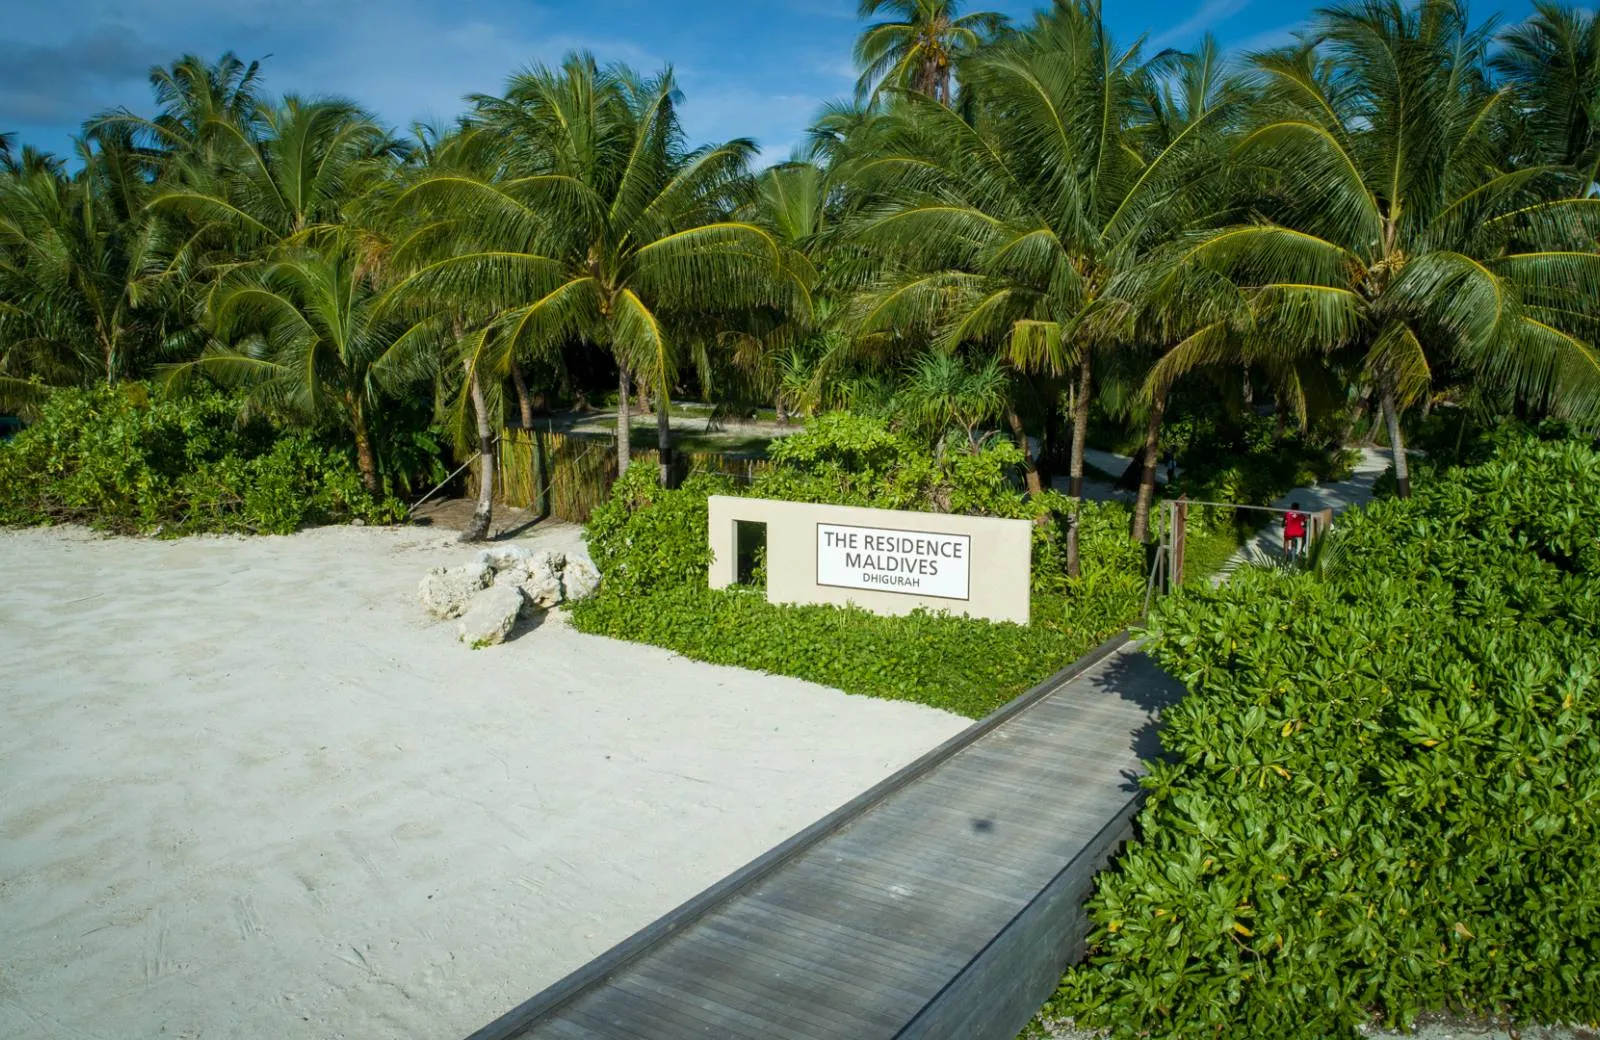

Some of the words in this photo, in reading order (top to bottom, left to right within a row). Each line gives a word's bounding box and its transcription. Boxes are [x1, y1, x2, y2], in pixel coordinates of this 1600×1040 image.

[824, 531, 858, 549] THE
[864, 535, 962, 559] RESIDENCE
[845, 552, 938, 576] MALDIVES
[862, 572, 920, 588] DHIGURAH
